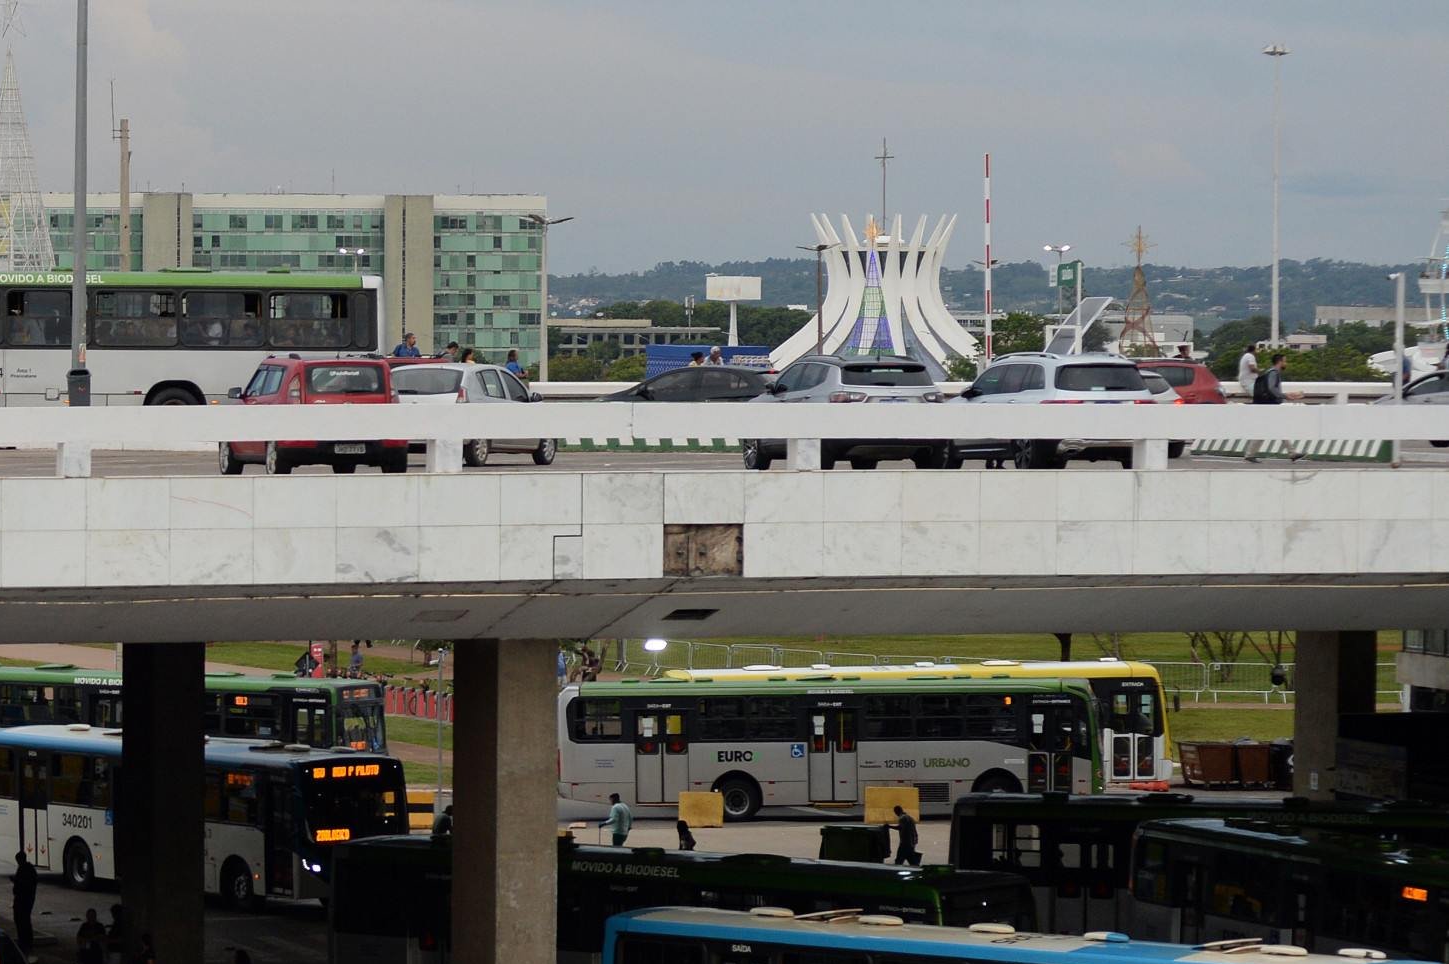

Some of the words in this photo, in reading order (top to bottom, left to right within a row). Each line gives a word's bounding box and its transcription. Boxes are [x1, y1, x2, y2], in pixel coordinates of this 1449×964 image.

[36, 273, 45, 284] A
[46, 273, 105, 285] BIODSEL
[73, 677, 101, 685] MOVIDO
[883, 759, 917, 769] 121690
[923, 757, 971, 768] URBANO
[62, 812, 93, 830] 340201
[570, 860, 614, 875] MOVIDO
[614, 864, 623, 875] A
[623, 863, 681, 879] BIODIESEL
[731, 943, 752, 953] SAÍDA
